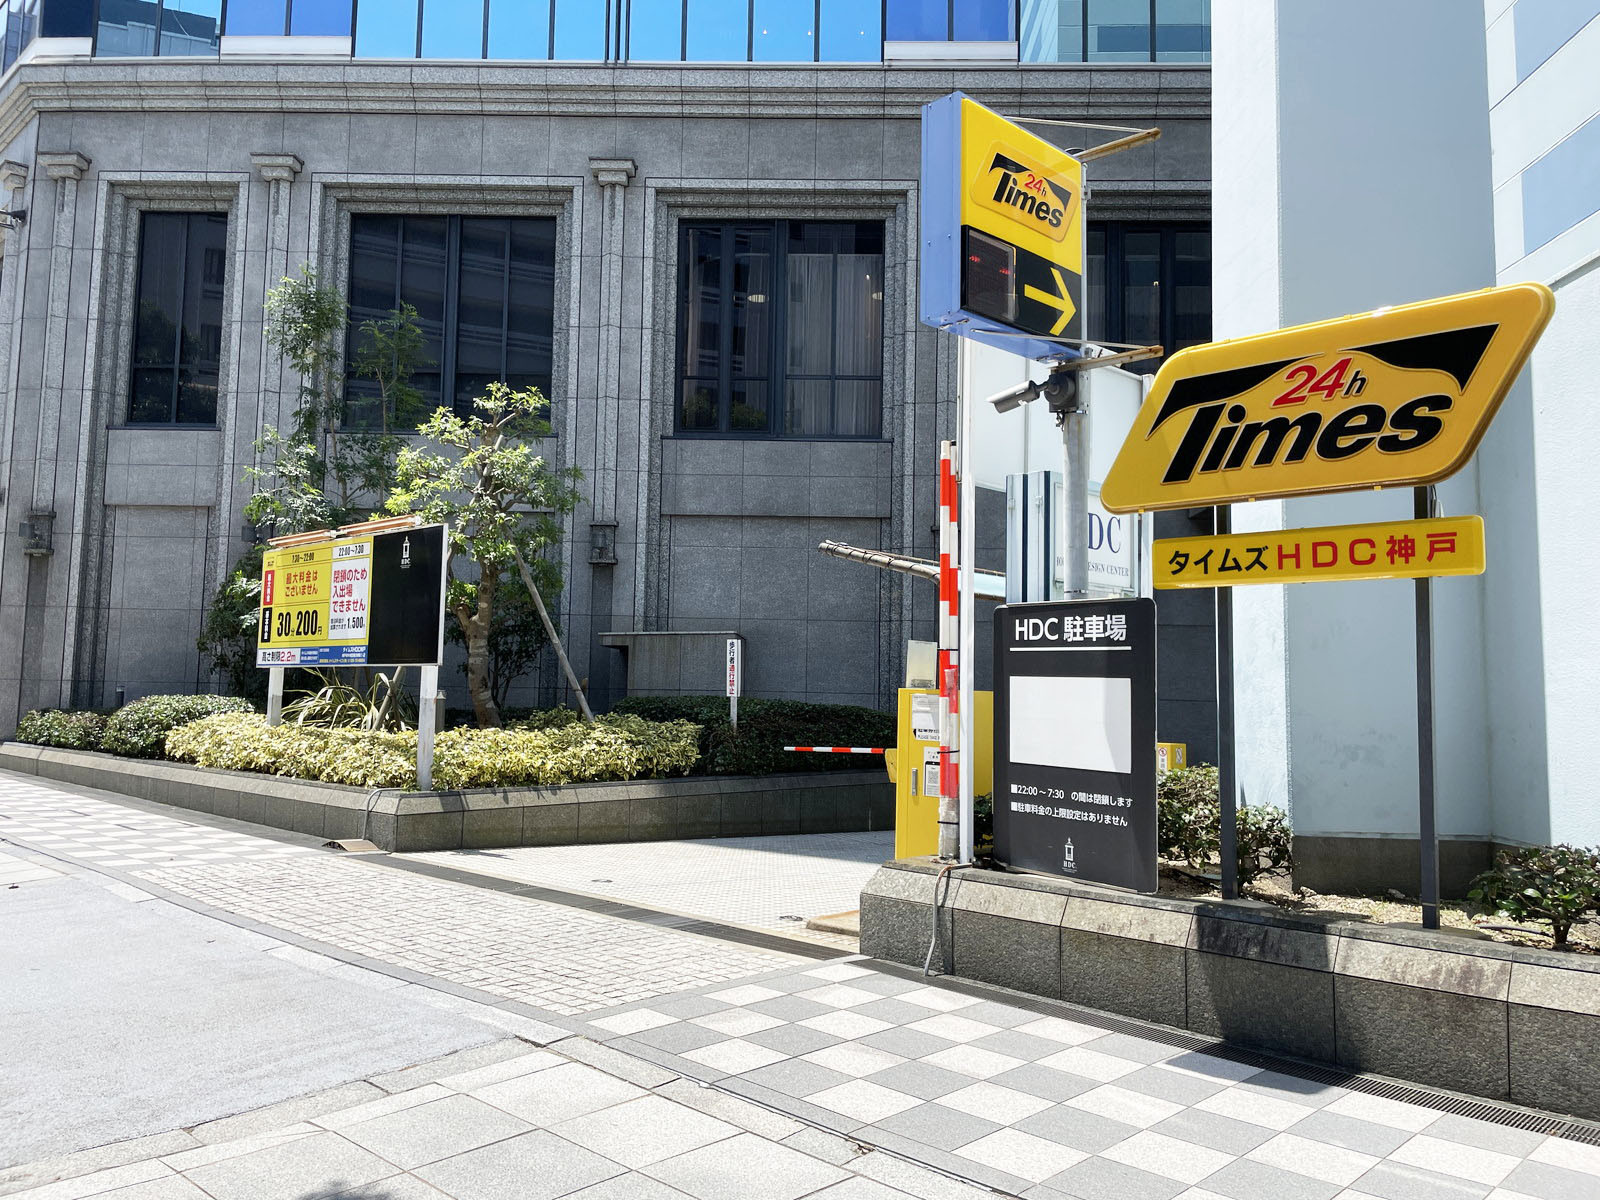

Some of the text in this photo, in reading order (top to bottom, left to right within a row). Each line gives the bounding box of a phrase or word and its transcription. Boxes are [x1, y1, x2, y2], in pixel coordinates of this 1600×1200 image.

[1024, 173, 1047, 197] 24h
[989, 166, 1064, 229] Times
[1271, 358, 1368, 409] 24h
[1150, 380, 1455, 486] Times
[1088, 513, 1120, 554] DC
[286, 570, 318, 585] 最大料金は
[333, 568, 368, 583] 閉鎖のため
[1087, 562, 1129, 577] ESIGN CENTER
[332, 583, 353, 599] 入出場
[332, 598, 366, 613] できません
[1015, 614, 1127, 642] HDC 駐車場
[1063, 860, 1077, 869] HDC
